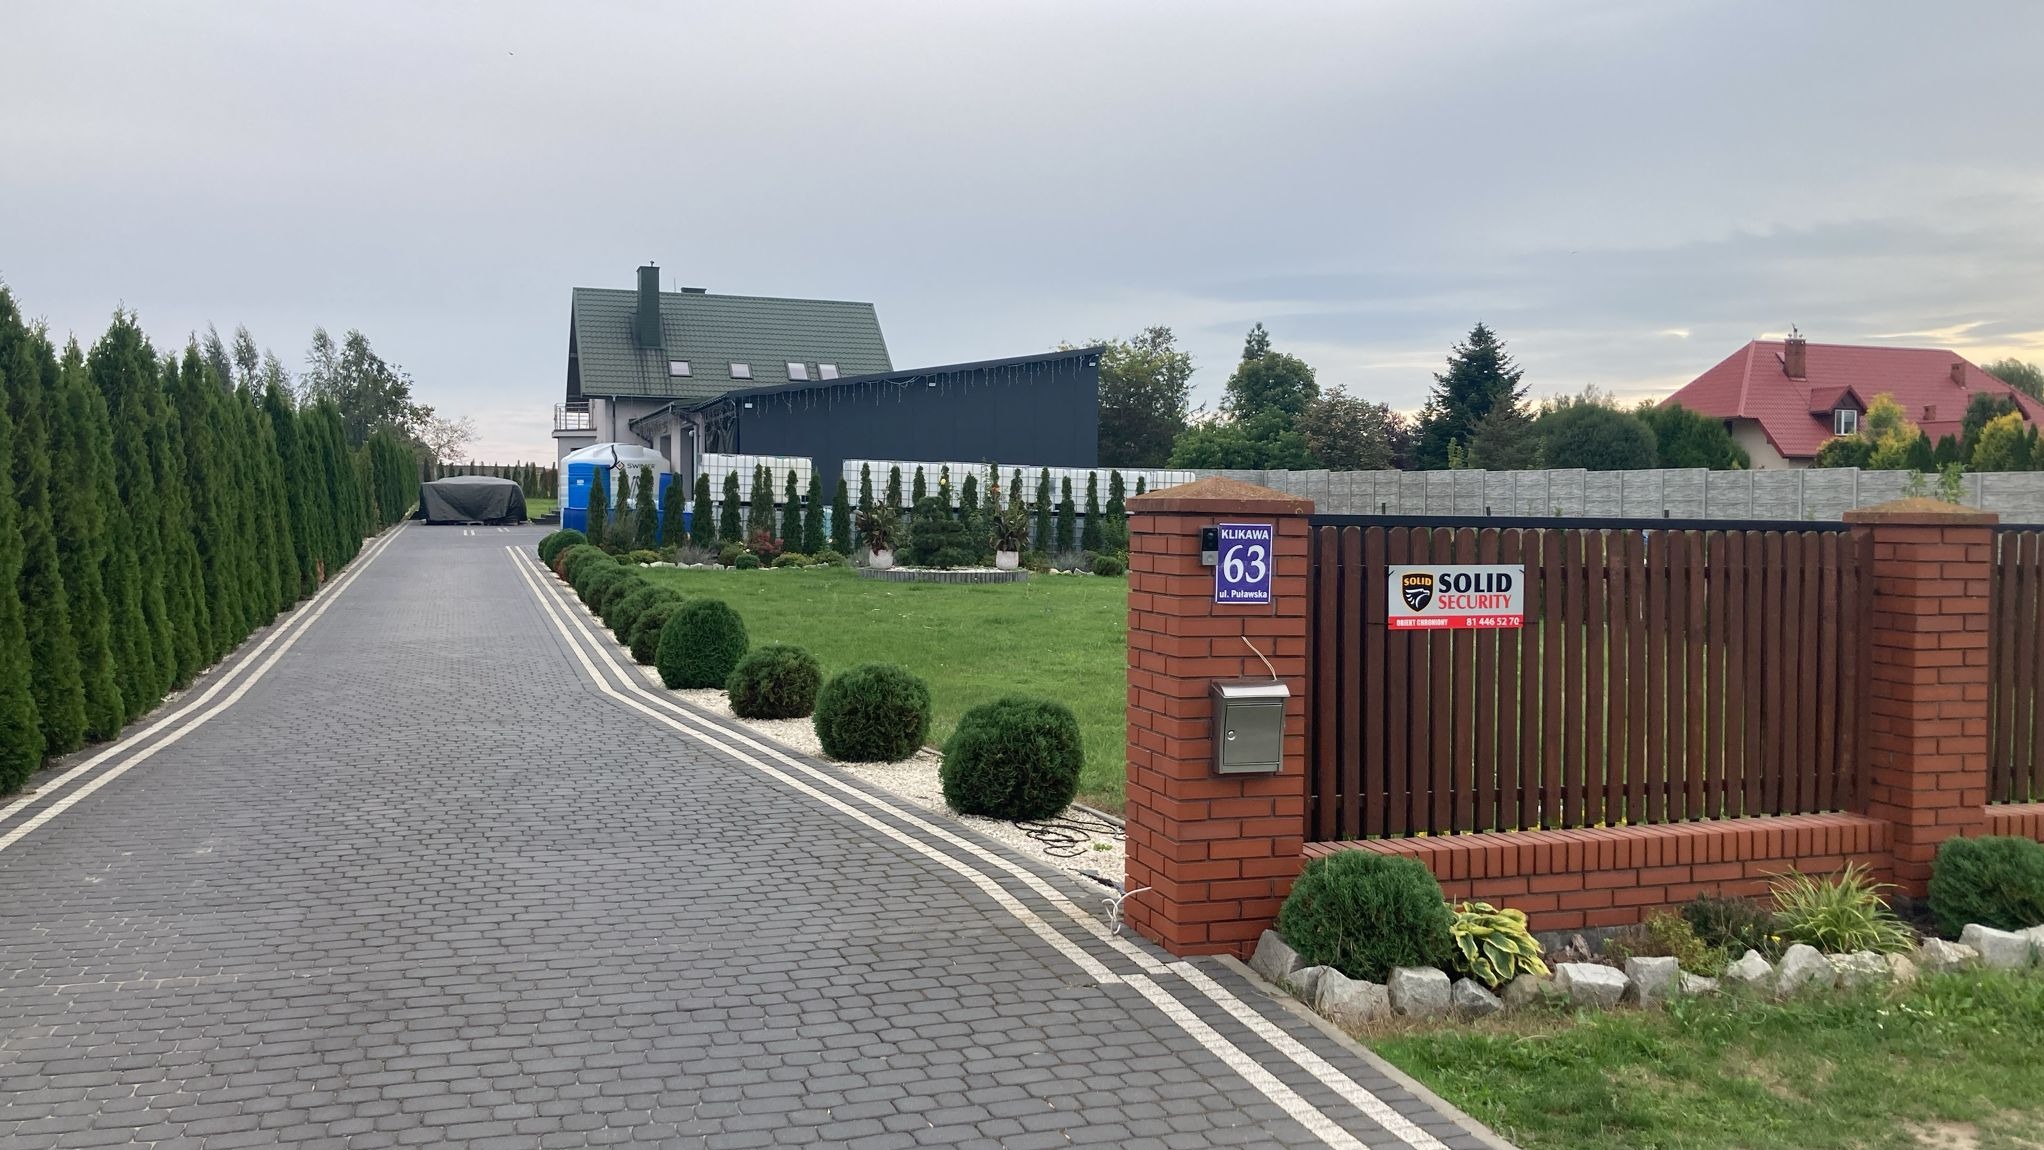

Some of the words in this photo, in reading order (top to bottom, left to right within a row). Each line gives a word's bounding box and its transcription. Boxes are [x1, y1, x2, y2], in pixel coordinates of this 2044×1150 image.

[1221, 529, 1269, 540] KLIKAWA
[1223, 544, 1266, 583] 63
[1403, 577, 1432, 586] SOLID
[1438, 573, 1512, 593] SOLID
[1219, 590, 1230, 598] ul.
[1231, 589, 1268, 598] Puławska
[1438, 594, 1512, 609] SECURITY
[1466, 618, 1477, 626] 81
[1478, 617, 1495, 625] 446
[1496, 617, 1508, 625] 52
[1508, 616, 1520, 625] 70
